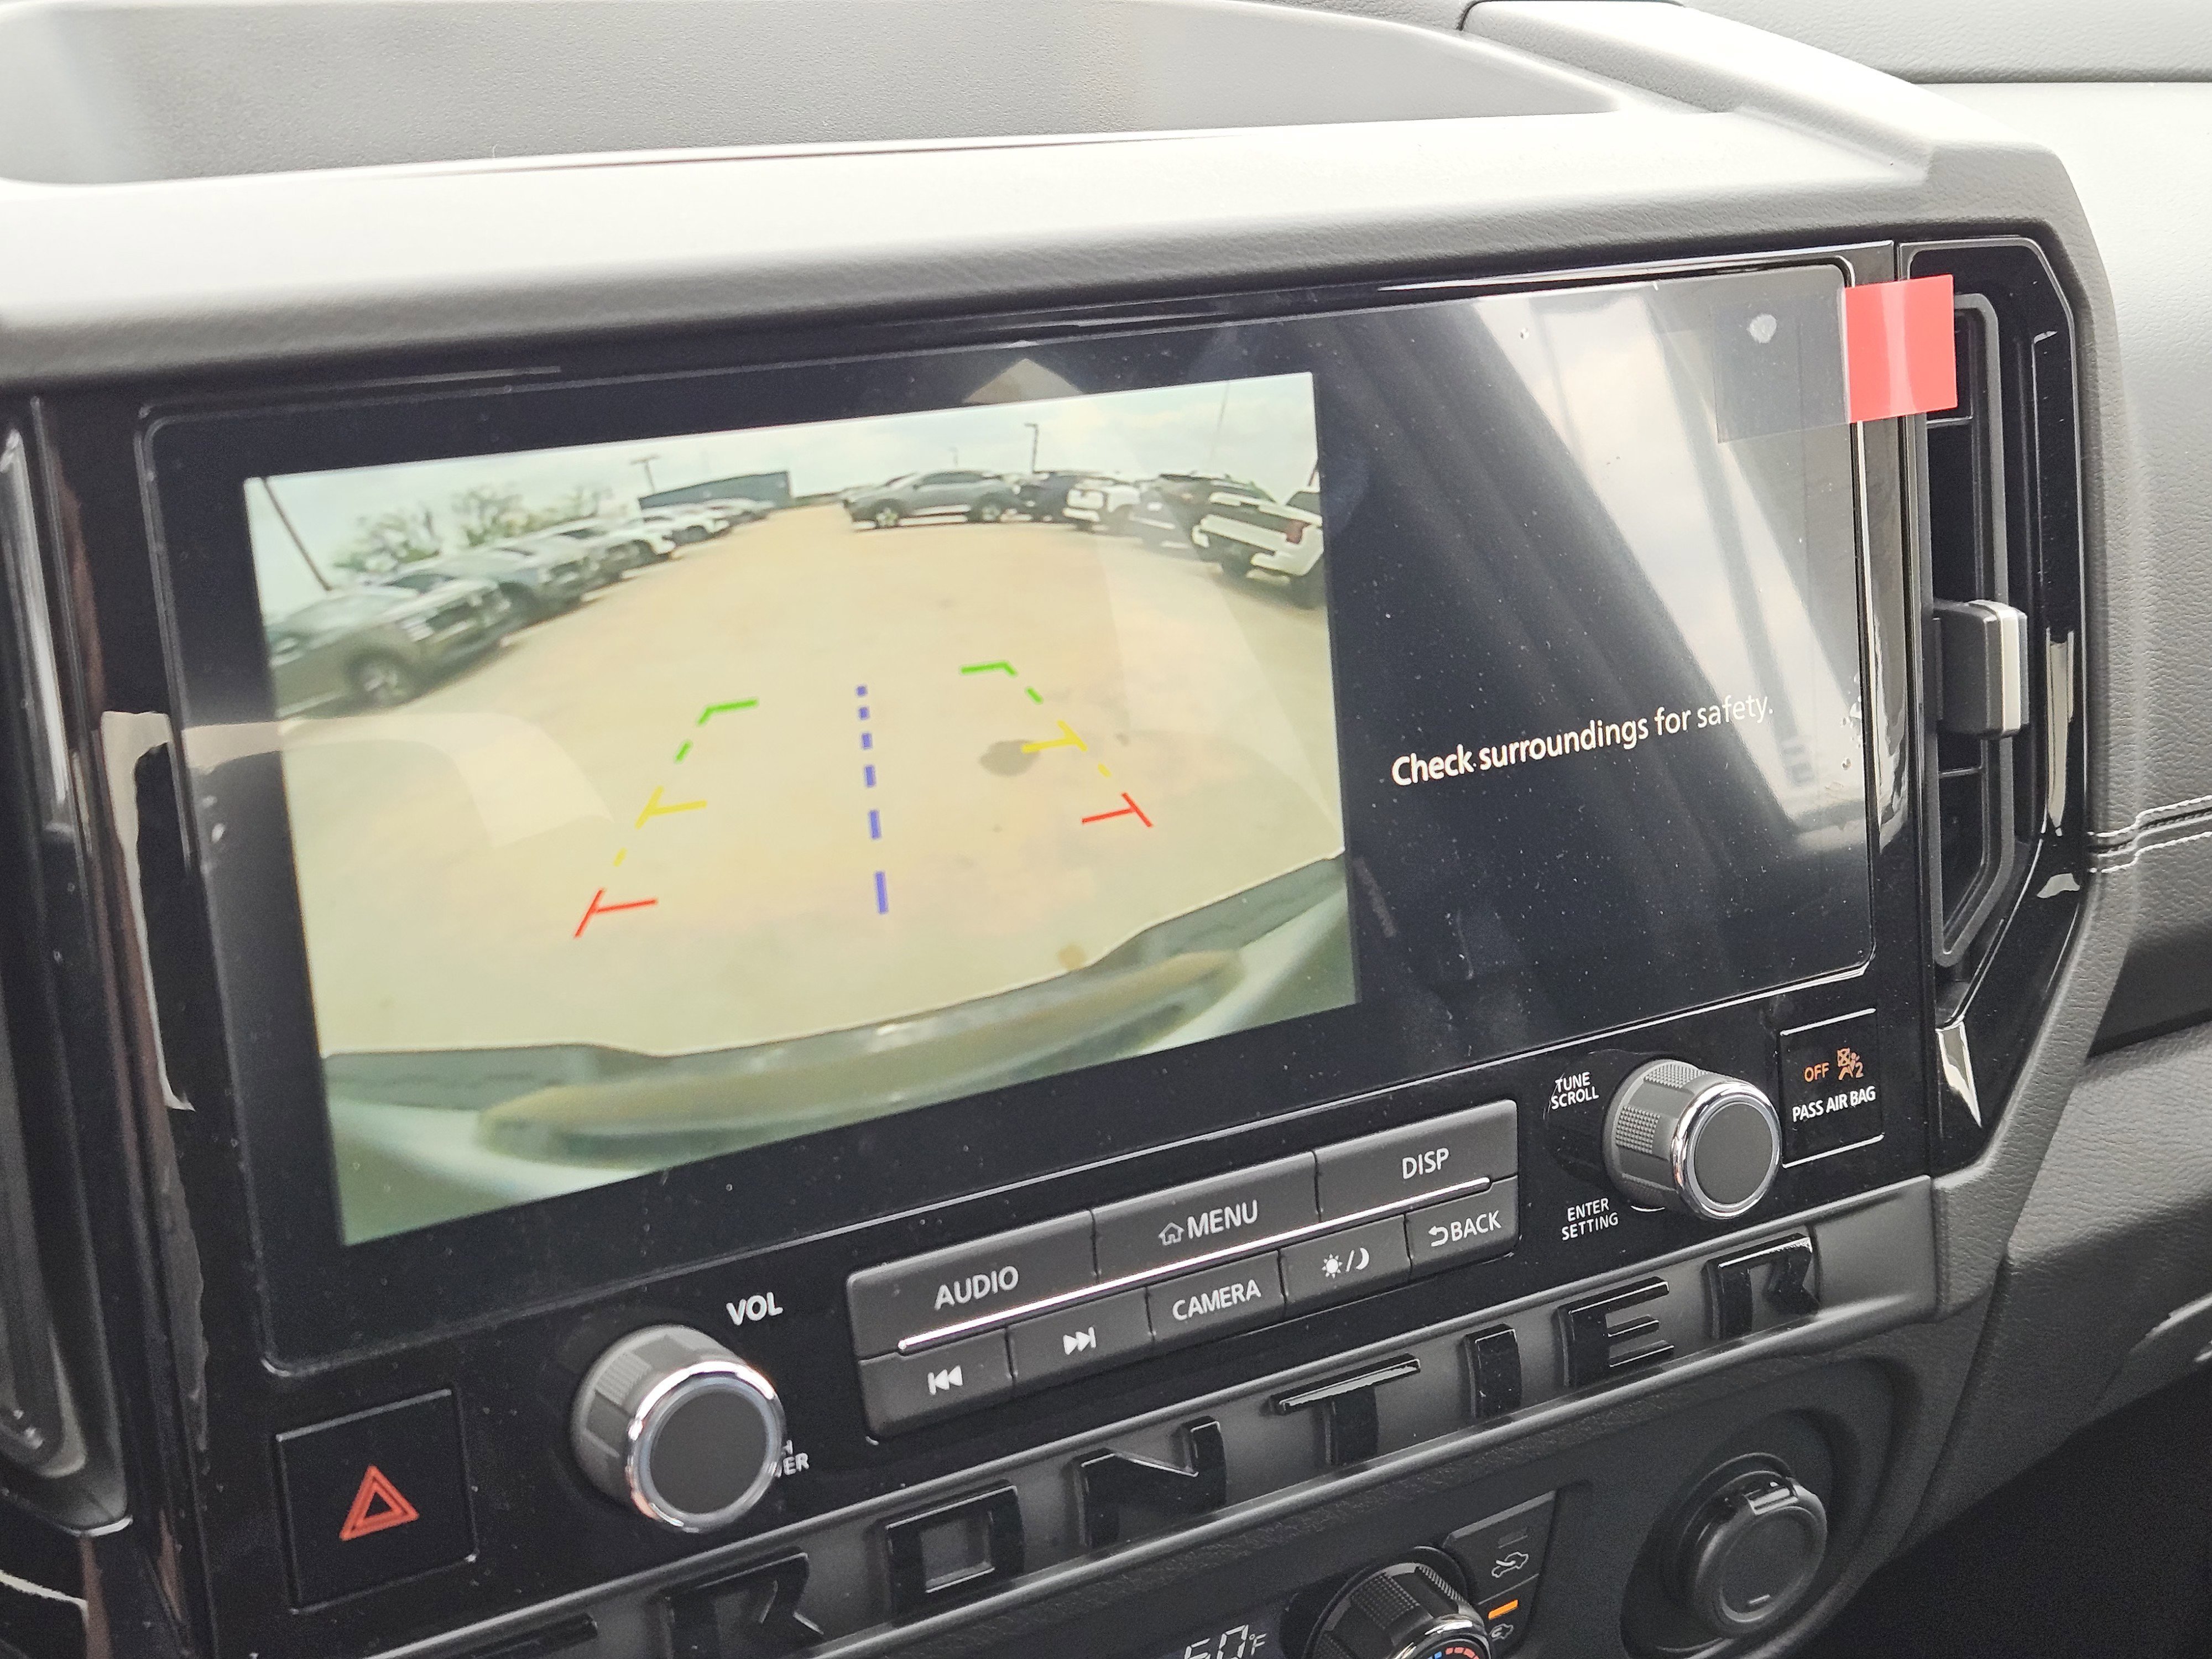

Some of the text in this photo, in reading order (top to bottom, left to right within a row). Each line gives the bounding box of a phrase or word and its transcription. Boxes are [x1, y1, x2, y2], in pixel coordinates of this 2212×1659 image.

[1390, 695, 1773, 786] Check surroundings for safety.
[1554, 1071, 1591, 1093] TUNE
[1804, 1062, 1829, 1082] OFF
[1551, 1086, 1600, 1110] SCROLL
[1792, 1085, 1876, 1123] PASS AIR BAG
[1401, 1147, 1450, 1180] DISP
[1186, 1199, 1259, 1239] MENU
[1450, 1209, 1502, 1242] BACK
[1567, 1197, 1610, 1222] ENTER
[1561, 1212, 1619, 1241] SETTING
[933, 1265, 1019, 1311] AUDIO
[1172, 1279, 1262, 1322] CAMERA
[726, 1291, 784, 1326] VOL
